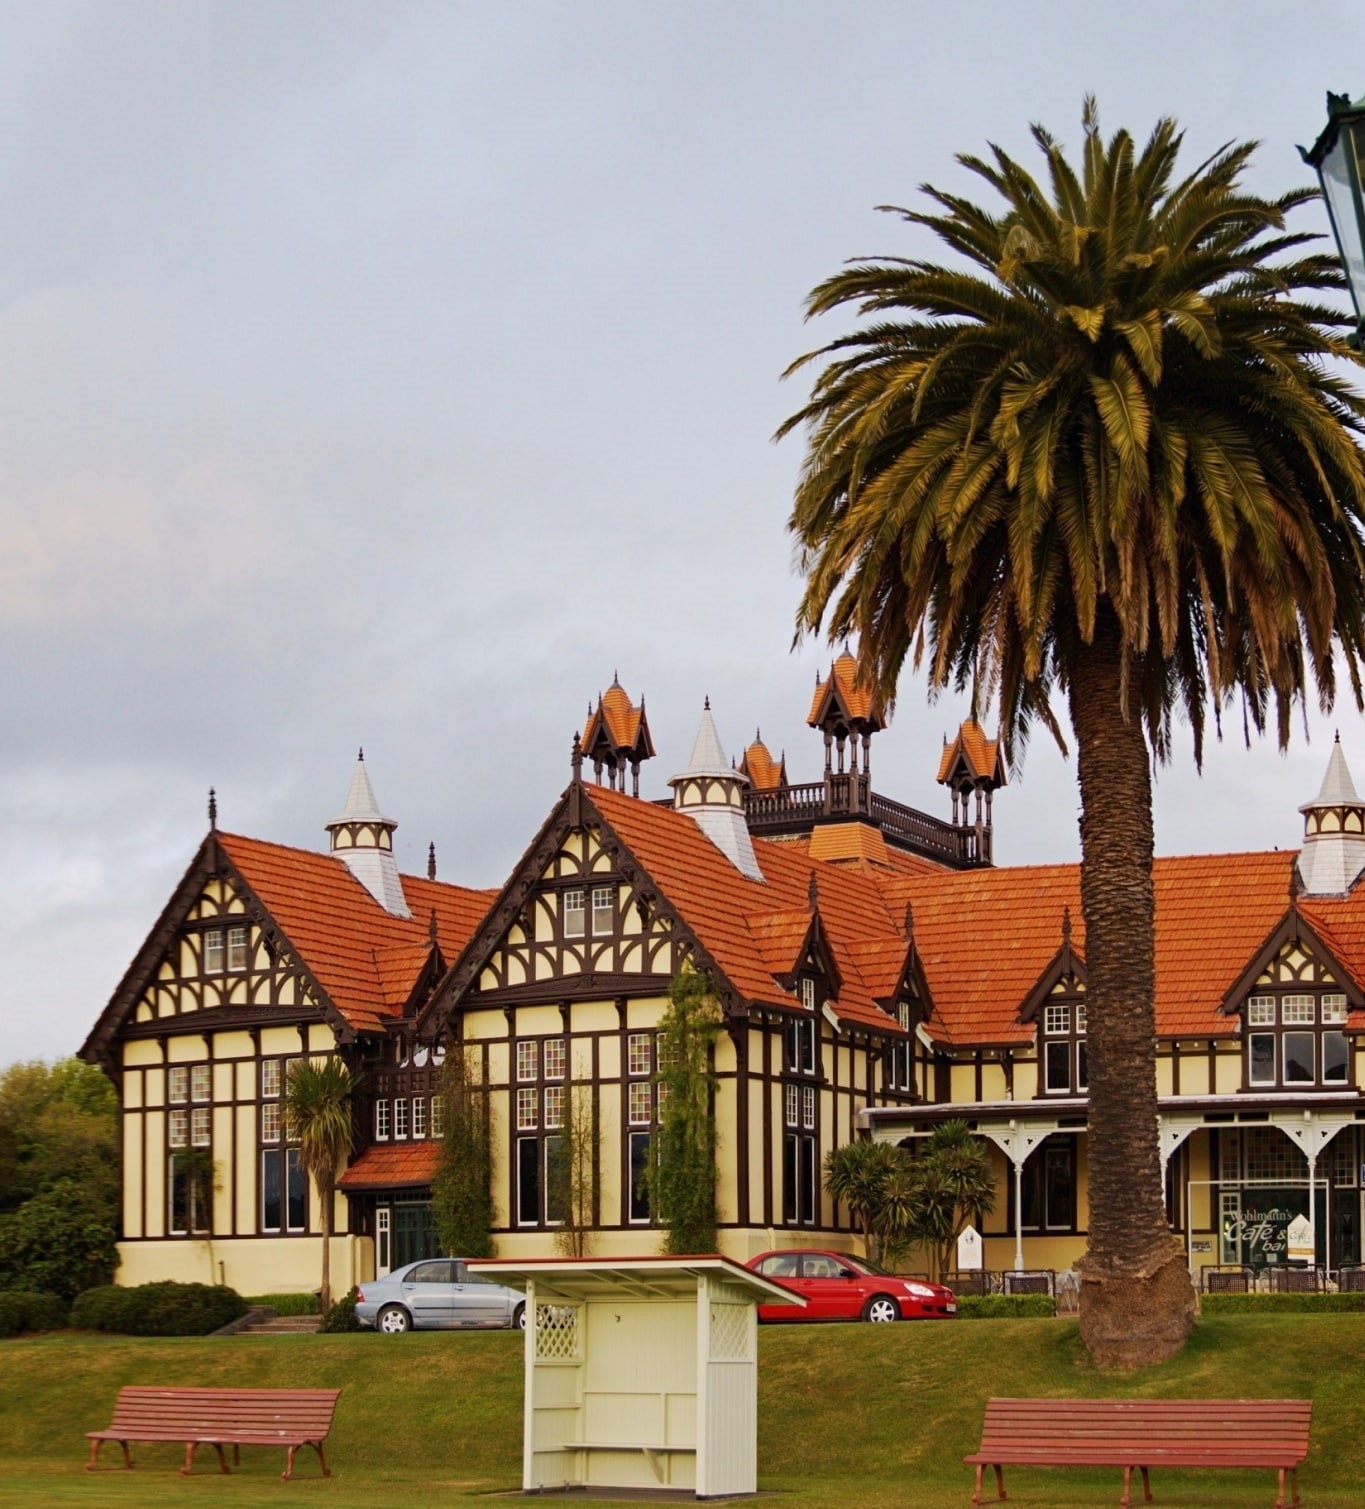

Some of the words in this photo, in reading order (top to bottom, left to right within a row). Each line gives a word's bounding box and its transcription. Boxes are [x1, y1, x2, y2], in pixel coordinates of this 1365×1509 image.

[1228, 1208, 1293, 1221] Wohlmann's
[1225, 1208, 1279, 1249] Café
[1276, 1229, 1287, 1241] &
